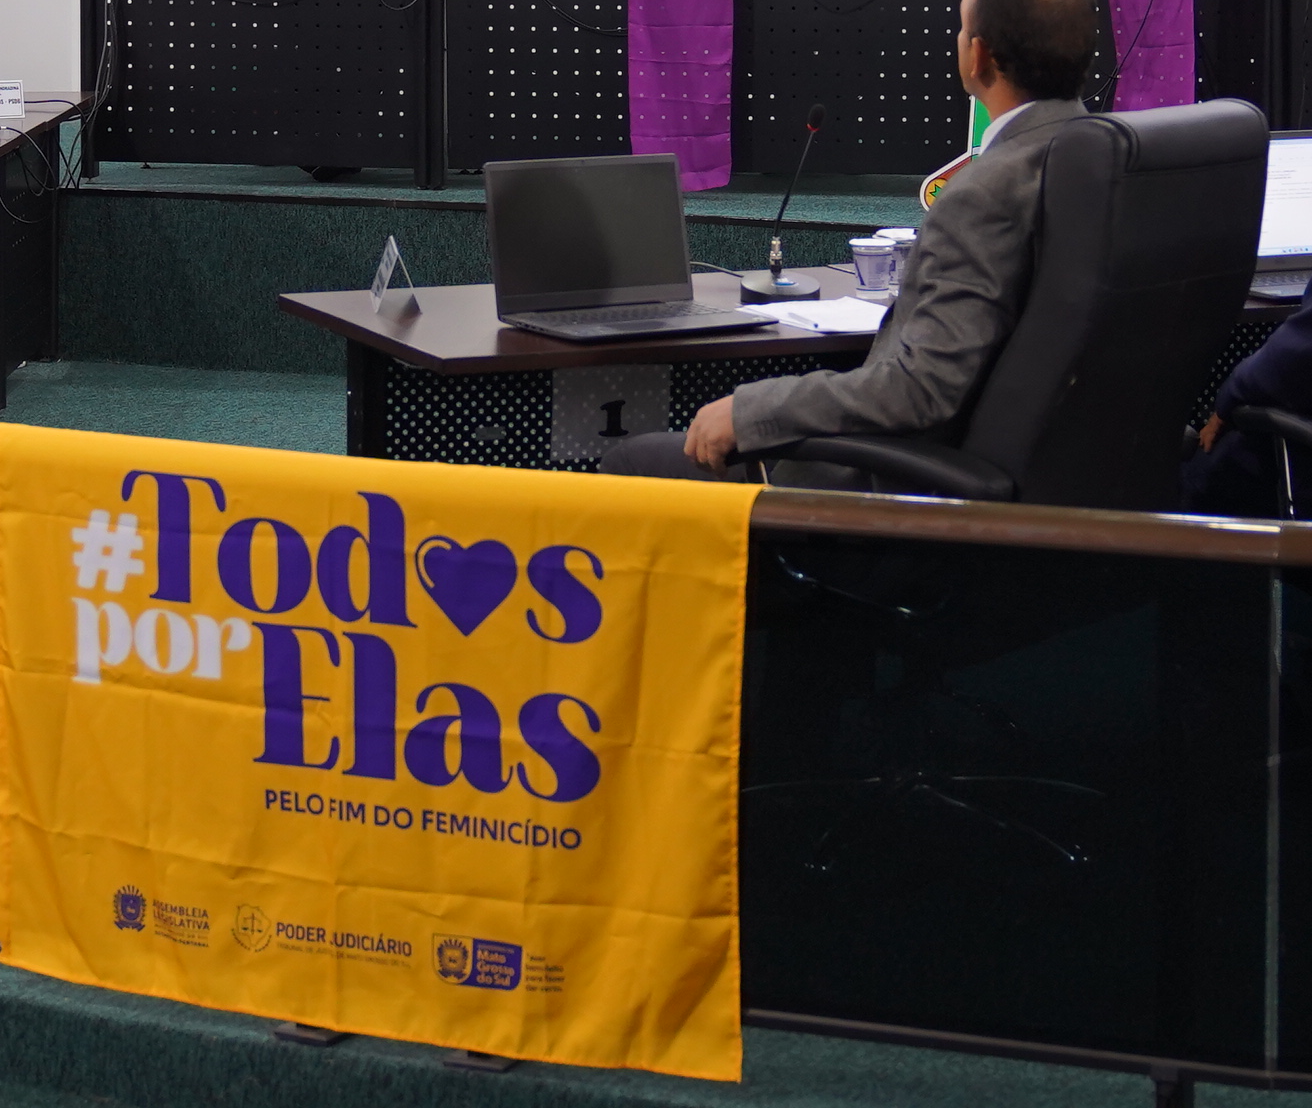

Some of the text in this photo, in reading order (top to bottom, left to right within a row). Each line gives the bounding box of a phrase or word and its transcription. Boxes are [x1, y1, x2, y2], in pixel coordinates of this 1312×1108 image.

[598, 400, 629, 437] 1
[71, 596, 252, 686] por
[253, 623, 603, 804] Elas
[264, 789, 583, 853] PELO FIM DO FEMINICÍDIO
[276, 922, 326, 943] PODER
